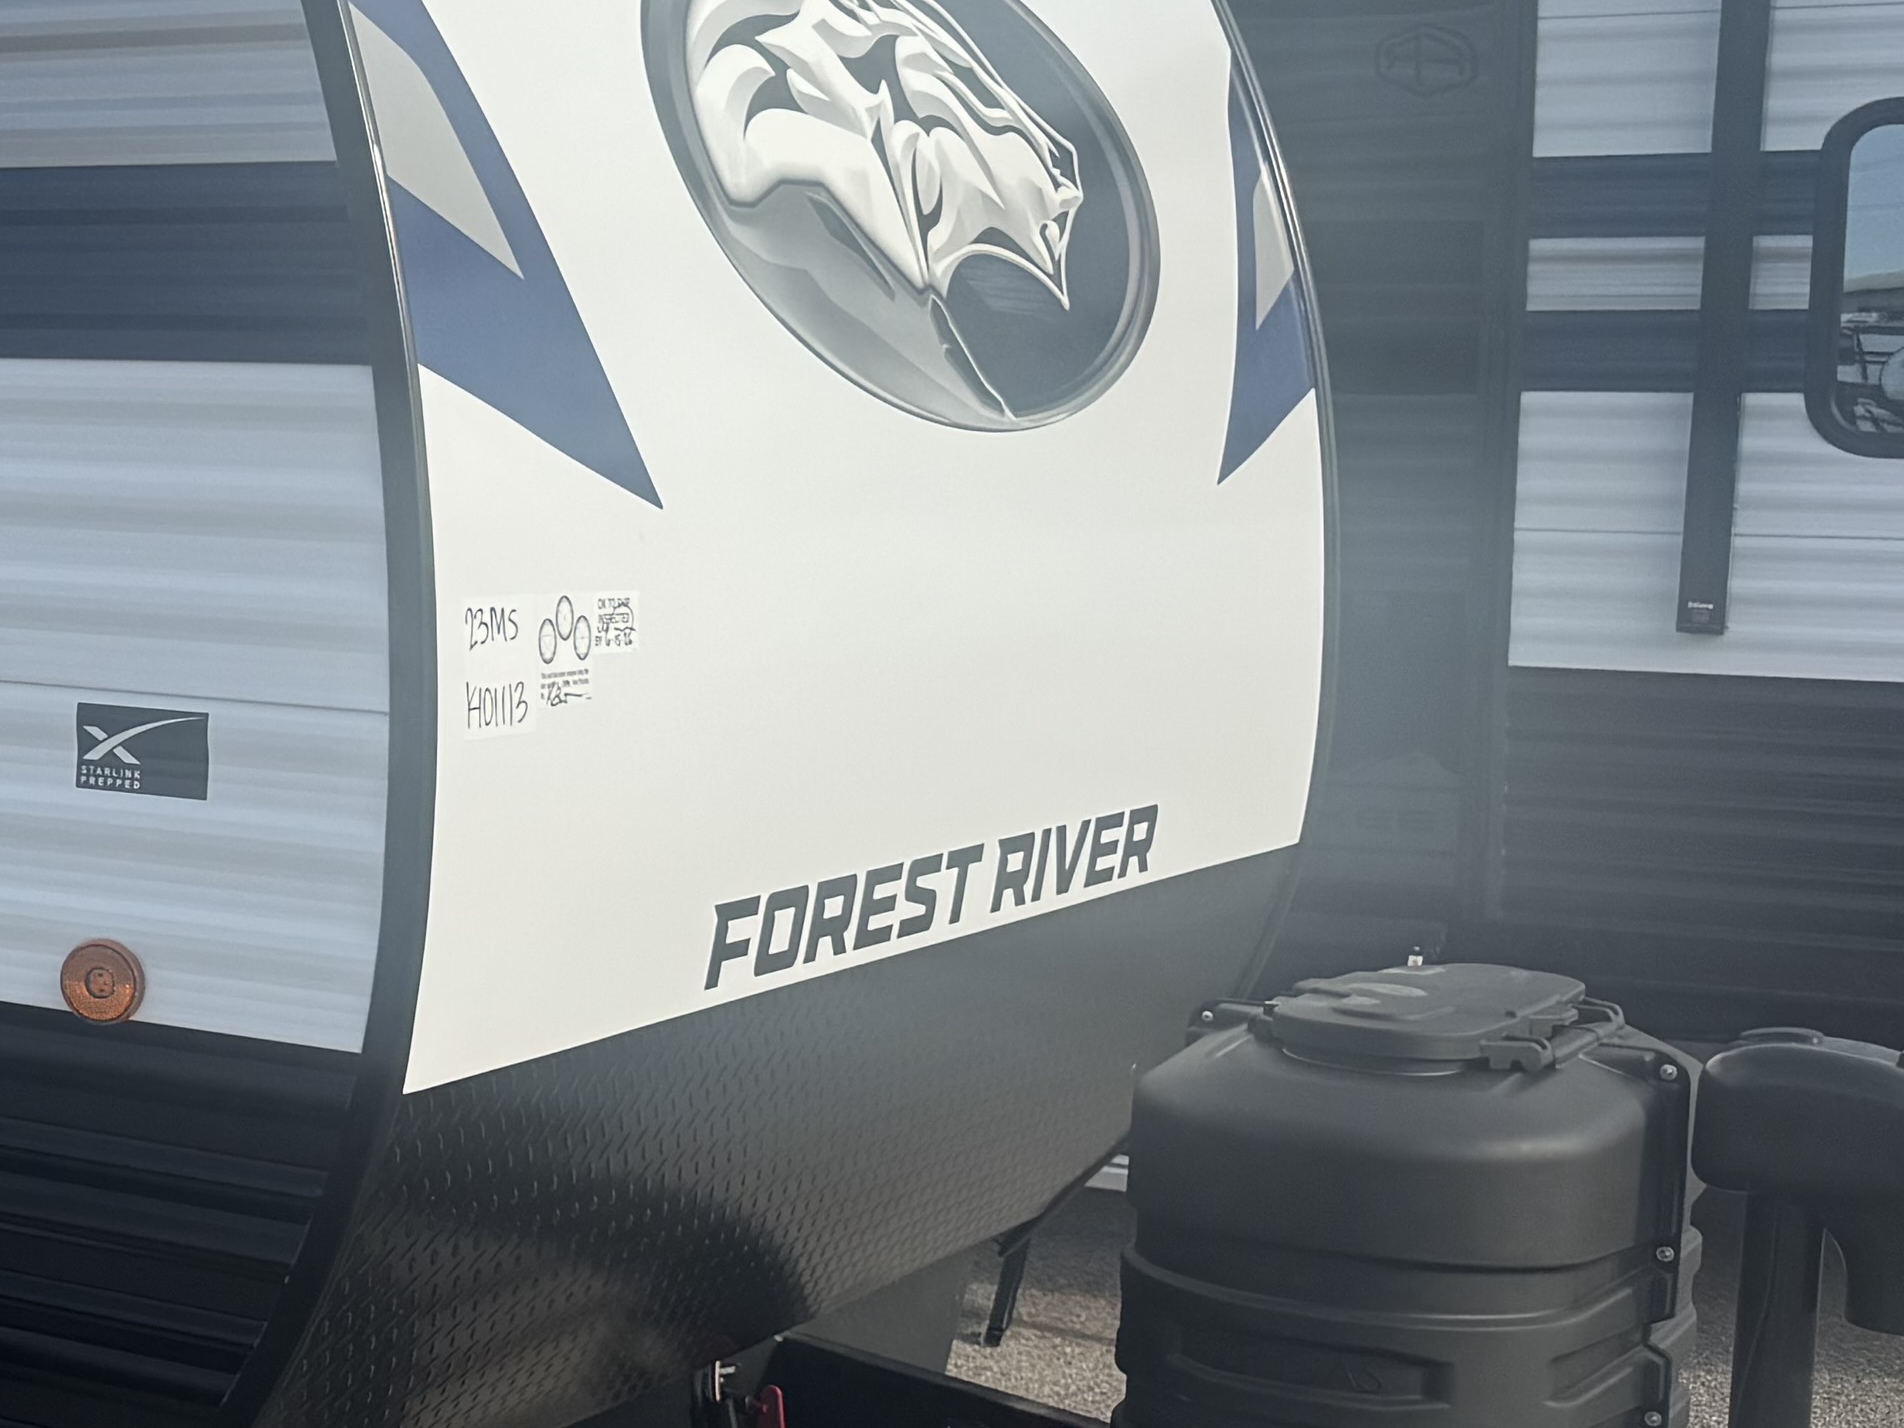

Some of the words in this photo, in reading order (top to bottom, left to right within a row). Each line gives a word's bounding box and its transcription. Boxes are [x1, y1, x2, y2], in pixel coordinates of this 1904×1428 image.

[81, 764, 141, 779] STARLINK
[80, 775, 141, 790] PREPPED
[703, 842, 986, 992] FOREST
[989, 803, 1160, 914] RIVER
